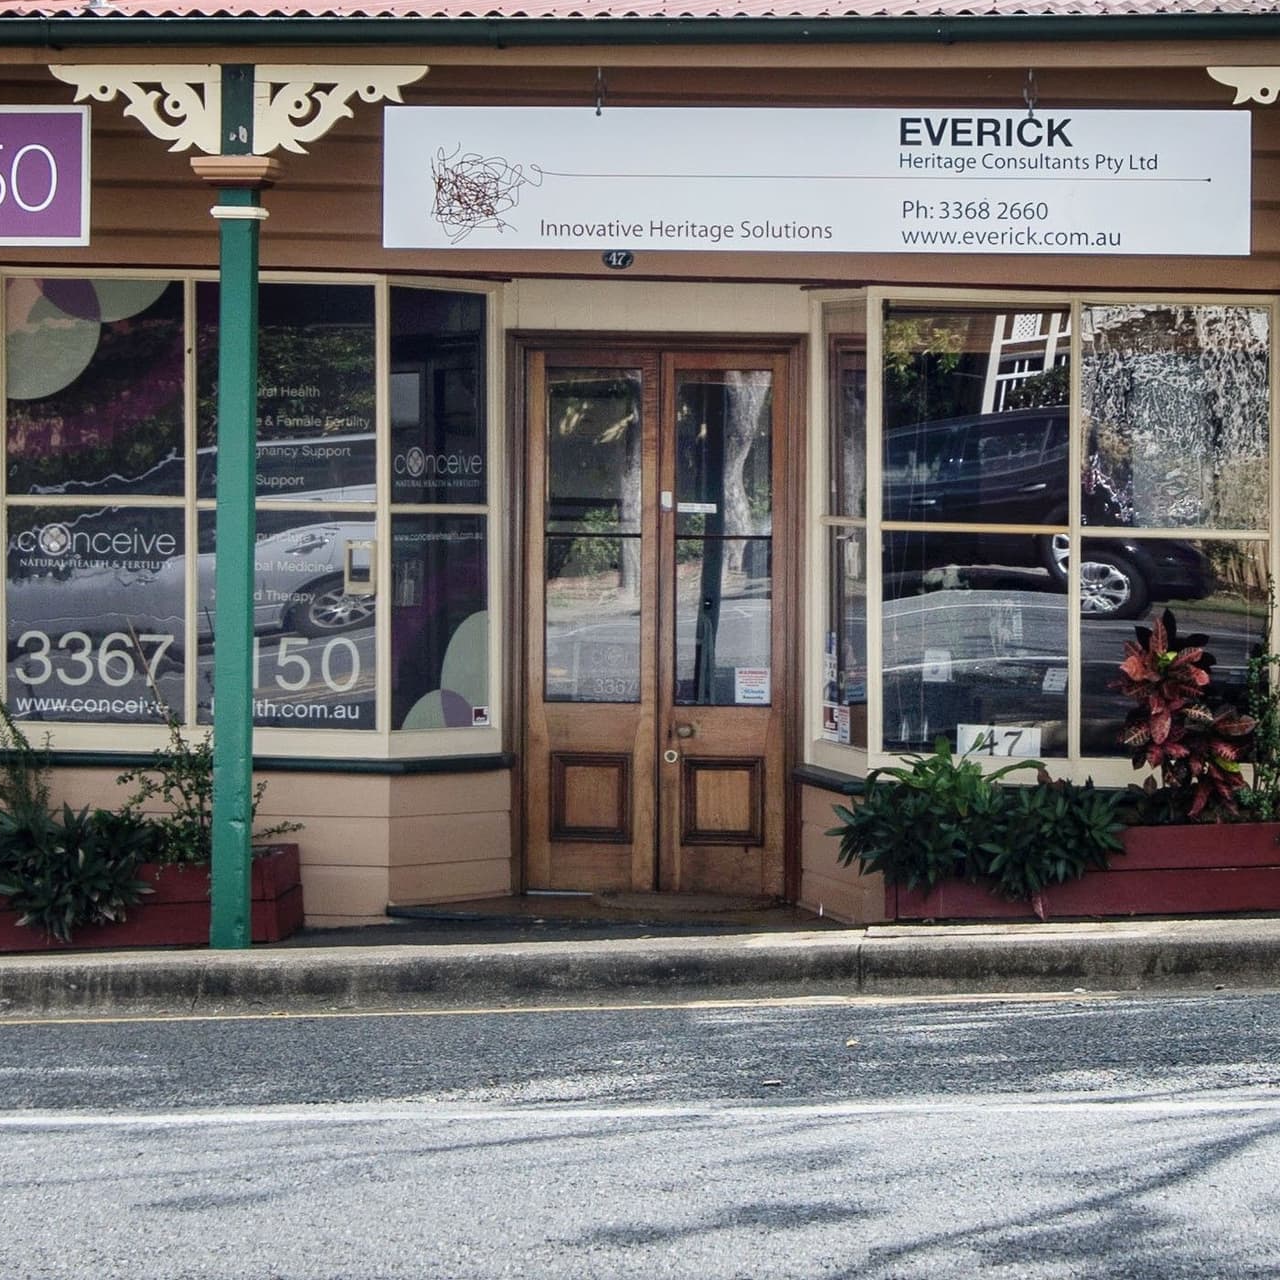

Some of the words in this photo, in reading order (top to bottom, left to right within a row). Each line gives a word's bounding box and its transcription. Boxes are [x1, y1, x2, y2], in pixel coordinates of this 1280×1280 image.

[900, 117, 1073, 147] EVERICK
[899, 152, 976, 173] Heritage
[982, 153, 1089, 171] Consultants
[1095, 154, 1123, 174] Pty
[1129, 154, 1158, 170] Ltd
[902, 200, 934, 219] Ph:
[939, 201, 990, 220] 3368
[997, 202, 1049, 220] 2660
[540, 219, 643, 238] Innovative
[649, 220, 734, 242] Heritage
[741, 220, 833, 240] Solutions
[901, 226, 1121, 246] www.everick.com.au
[607, 252, 626, 266] 47
[280, 385, 320, 397] Health
[277, 415, 321, 427] Female
[302, 446, 351, 460] Support
[256, 474, 305, 488] Support
[20, 558, 67, 569] NATURAL
[71, 559, 108, 569] HEALTH
[277, 561, 333, 573] Medicine
[266, 590, 316, 603] Therapy
[15, 630, 175, 687] 3367
[252, 637, 361, 692] 150
[977, 729, 1024, 757] 47
